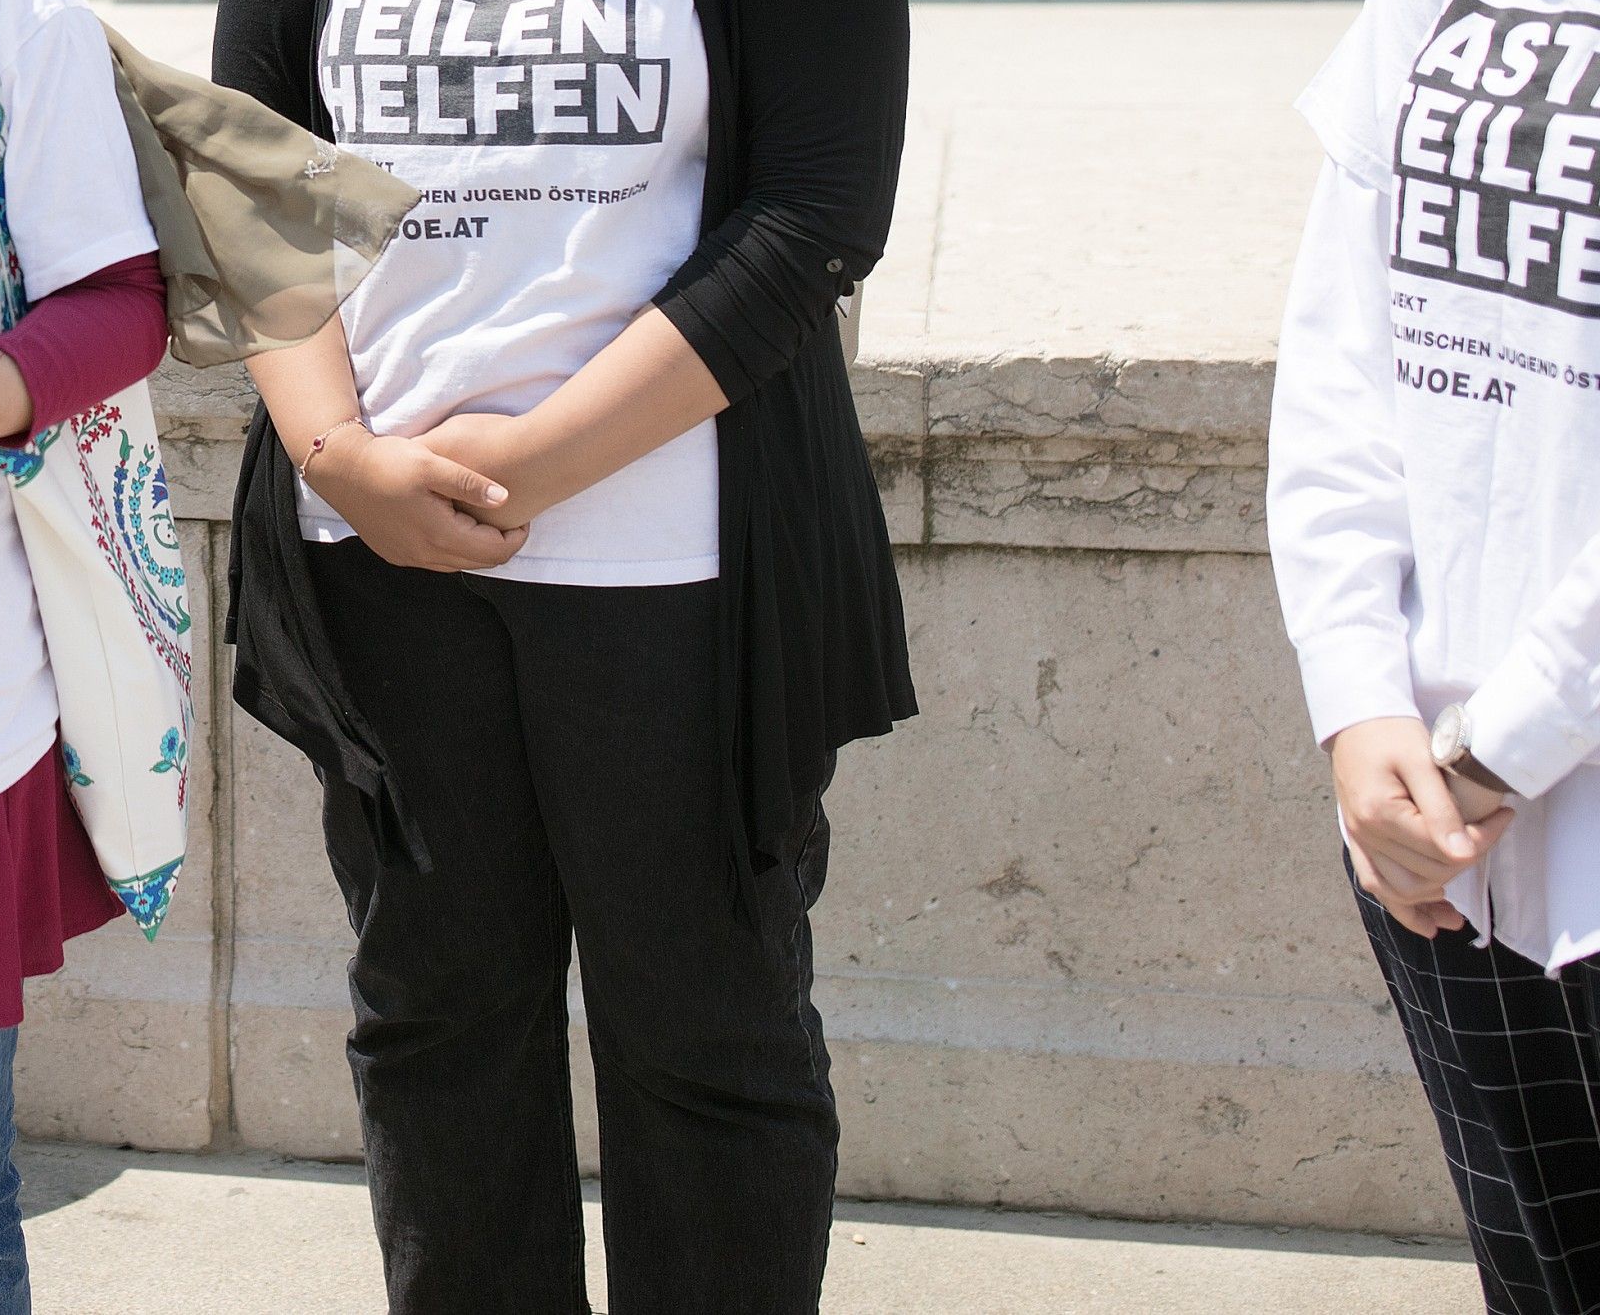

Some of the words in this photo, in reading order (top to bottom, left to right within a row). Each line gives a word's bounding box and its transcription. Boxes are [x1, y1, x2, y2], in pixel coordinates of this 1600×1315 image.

[323, 64, 662, 134] HELFEN
[1401, 82, 1600, 205] EILE
[463, 188, 542, 202] JUGEND
[549, 180, 650, 204] ÖSTERREICH
[391, 217, 489, 240] OE.AT
[1390, 173, 1600, 305] ELFE
[1397, 358, 1516, 406] MJOE.AT
[1498, 345, 1558, 379] JUGEND
